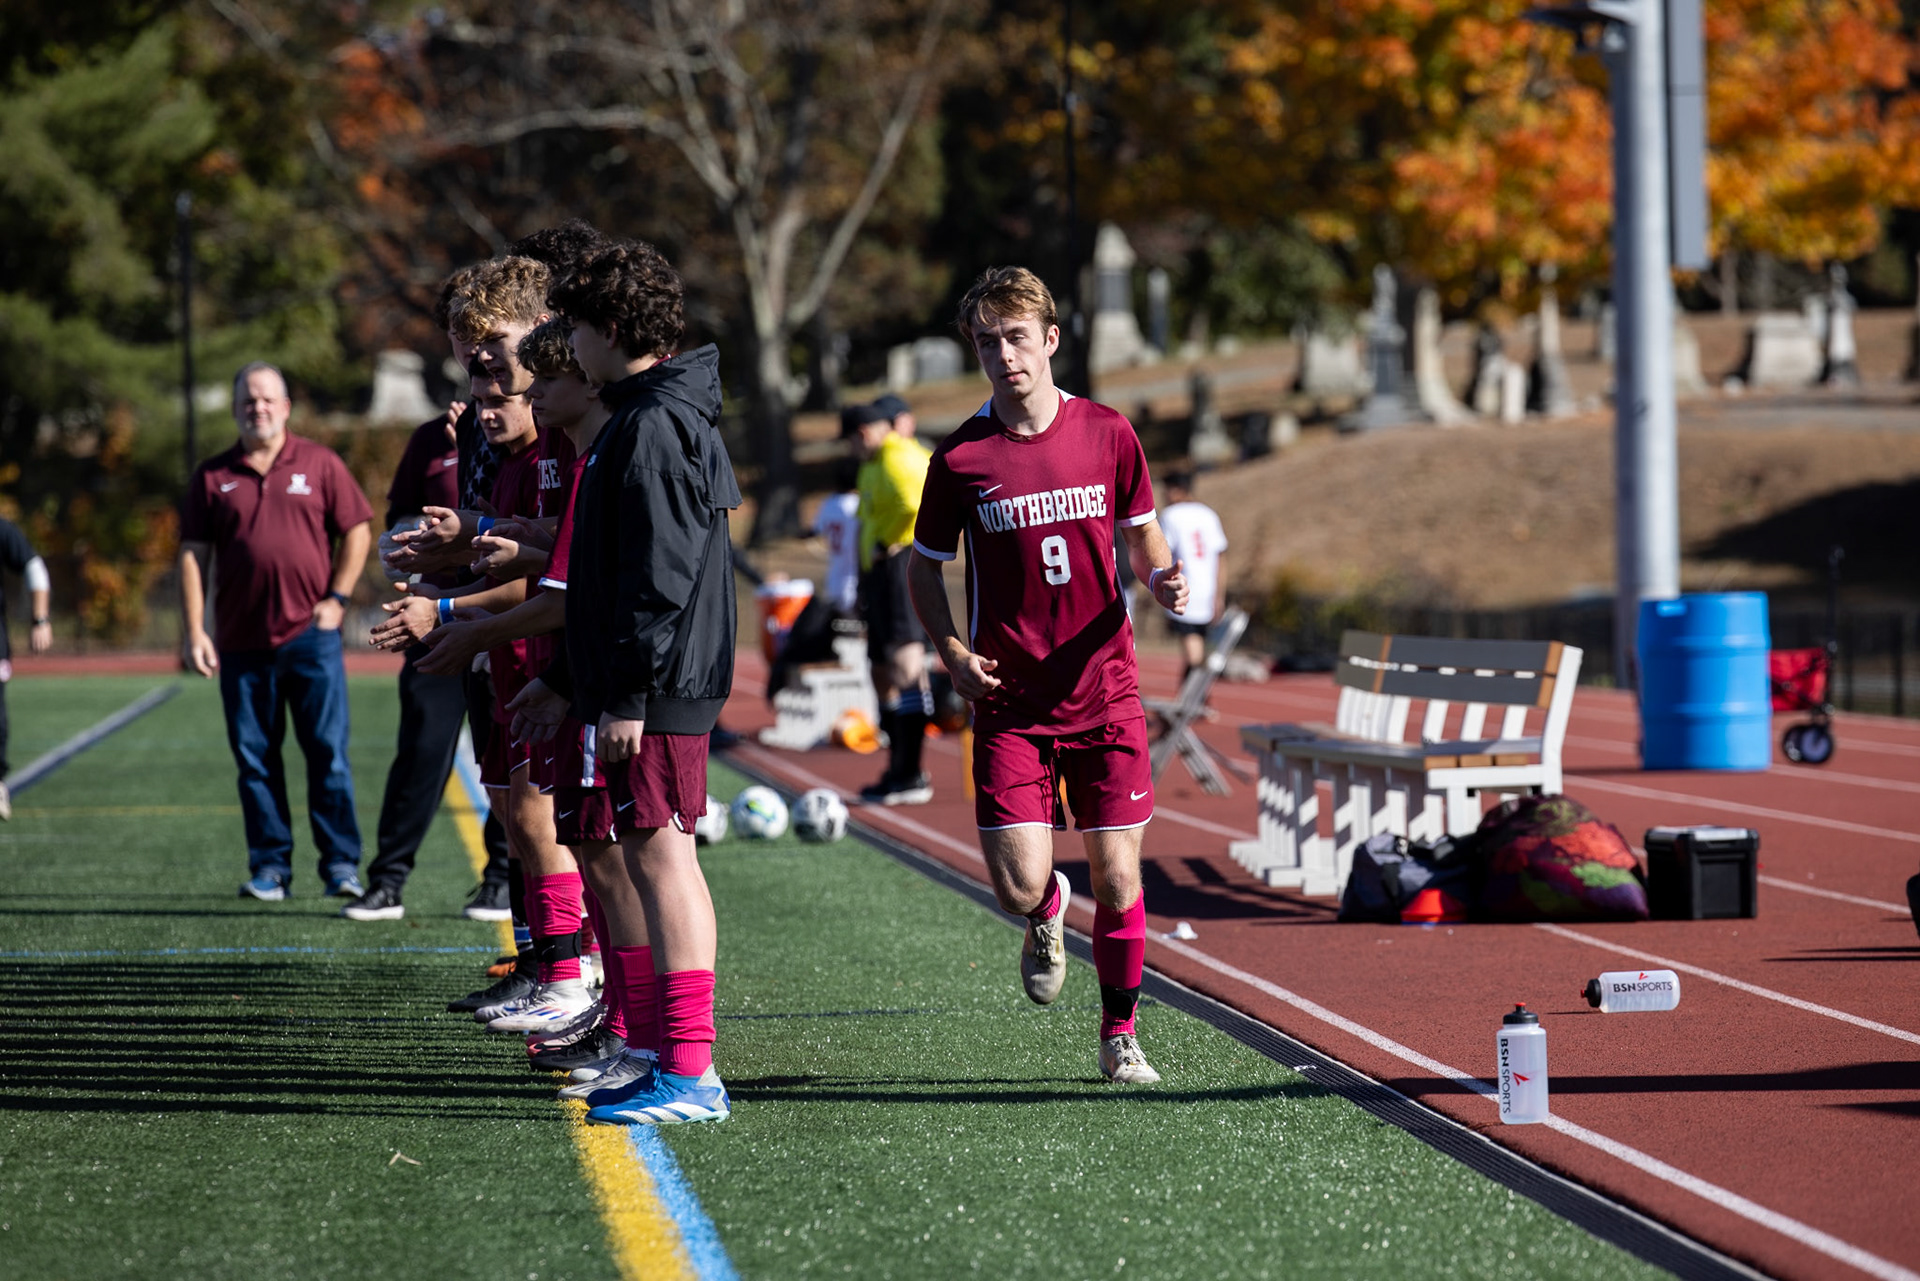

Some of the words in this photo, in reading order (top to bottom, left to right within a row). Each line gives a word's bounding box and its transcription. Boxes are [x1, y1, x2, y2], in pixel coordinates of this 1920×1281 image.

[977, 485, 1106, 533] NORTHBRIDGE
[1041, 535, 1071, 586] 9
[1613, 983, 1636, 993] BSN
[1637, 981, 1673, 992] SPORTS
[1501, 1038, 1509, 1067] BSN
[1502, 1068, 1511, 1114] SPORTS
